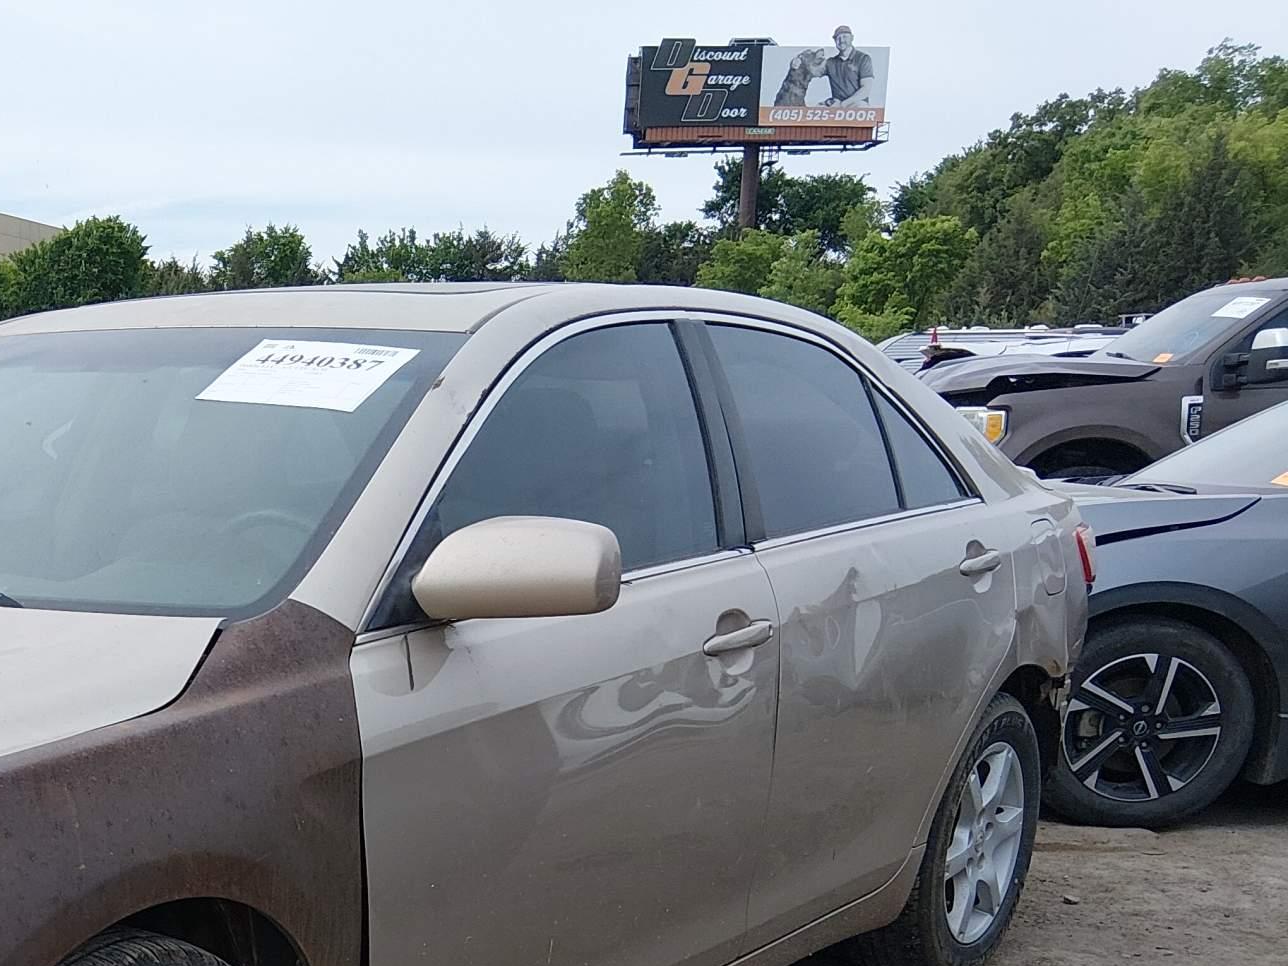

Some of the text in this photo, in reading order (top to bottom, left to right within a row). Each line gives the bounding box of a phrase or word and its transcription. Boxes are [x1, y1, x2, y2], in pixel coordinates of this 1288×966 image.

[651, 38, 749, 70] Discount
[665, 62, 750, 94] Garage
[681, 89, 747, 121] Door
[769, 109, 876, 122] (405) 525-DOOR
[256, 353, 385, 371] 44940387
